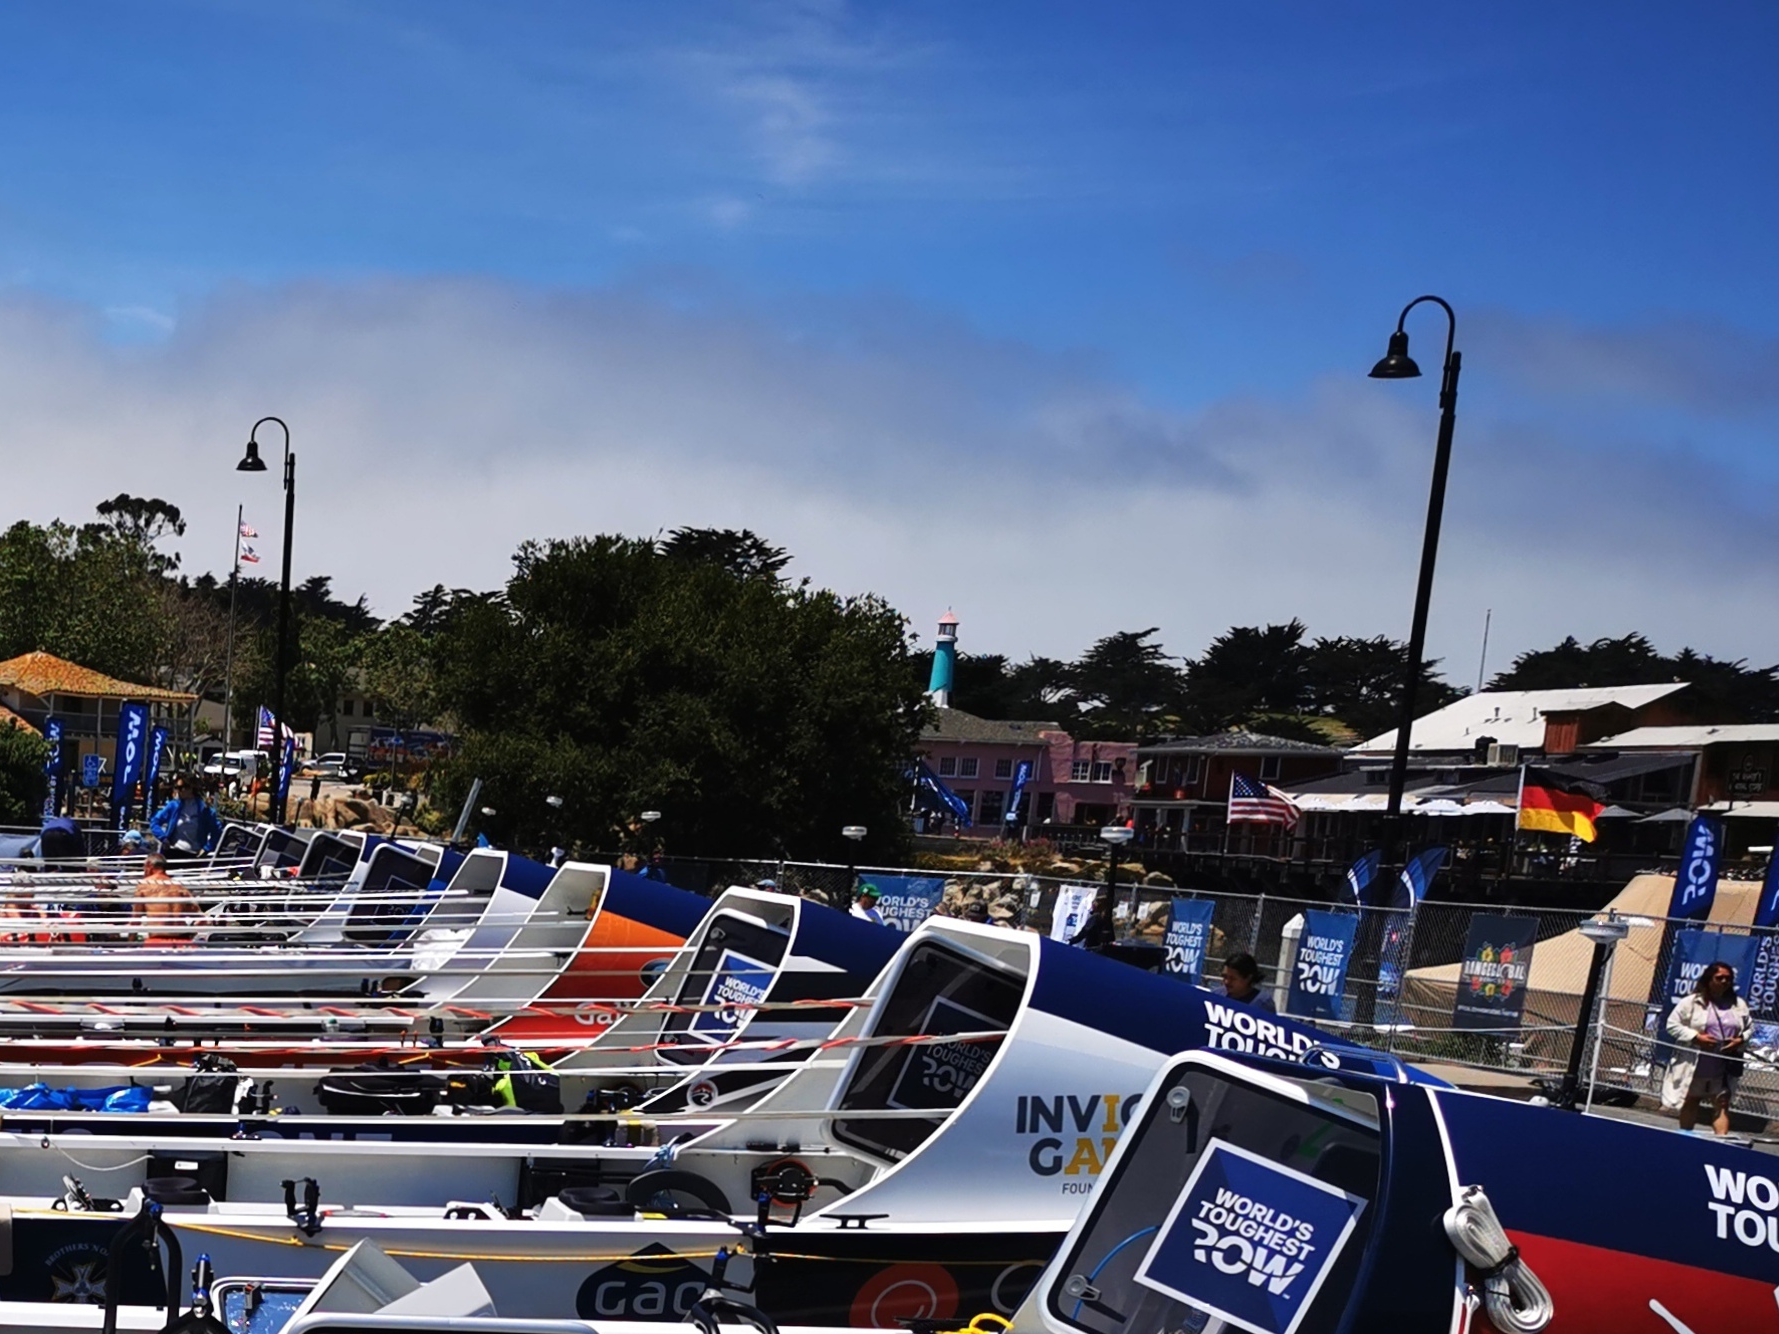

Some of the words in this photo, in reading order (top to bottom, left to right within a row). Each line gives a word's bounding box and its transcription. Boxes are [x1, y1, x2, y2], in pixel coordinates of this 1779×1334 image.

[1681, 824, 1715, 906] ROW
[1165, 933, 1204, 949] TOUGHEST
[1172, 920, 1204, 936] WORLD'S
[1164, 945, 1201, 975] ROW
[1299, 947, 1344, 967] TOUGHEST
[1307, 935, 1344, 954] WORLD'S
[1297, 961, 1340, 996] ROW
[926, 1045, 984, 1075] TOUGHES
[938, 1032, 993, 1064] ORLD'S
[1215, 1186, 1315, 1242] WORLD'S
[1198, 1200, 1317, 1261] TOUGHEST
[1191, 1217, 1305, 1296] ROW
